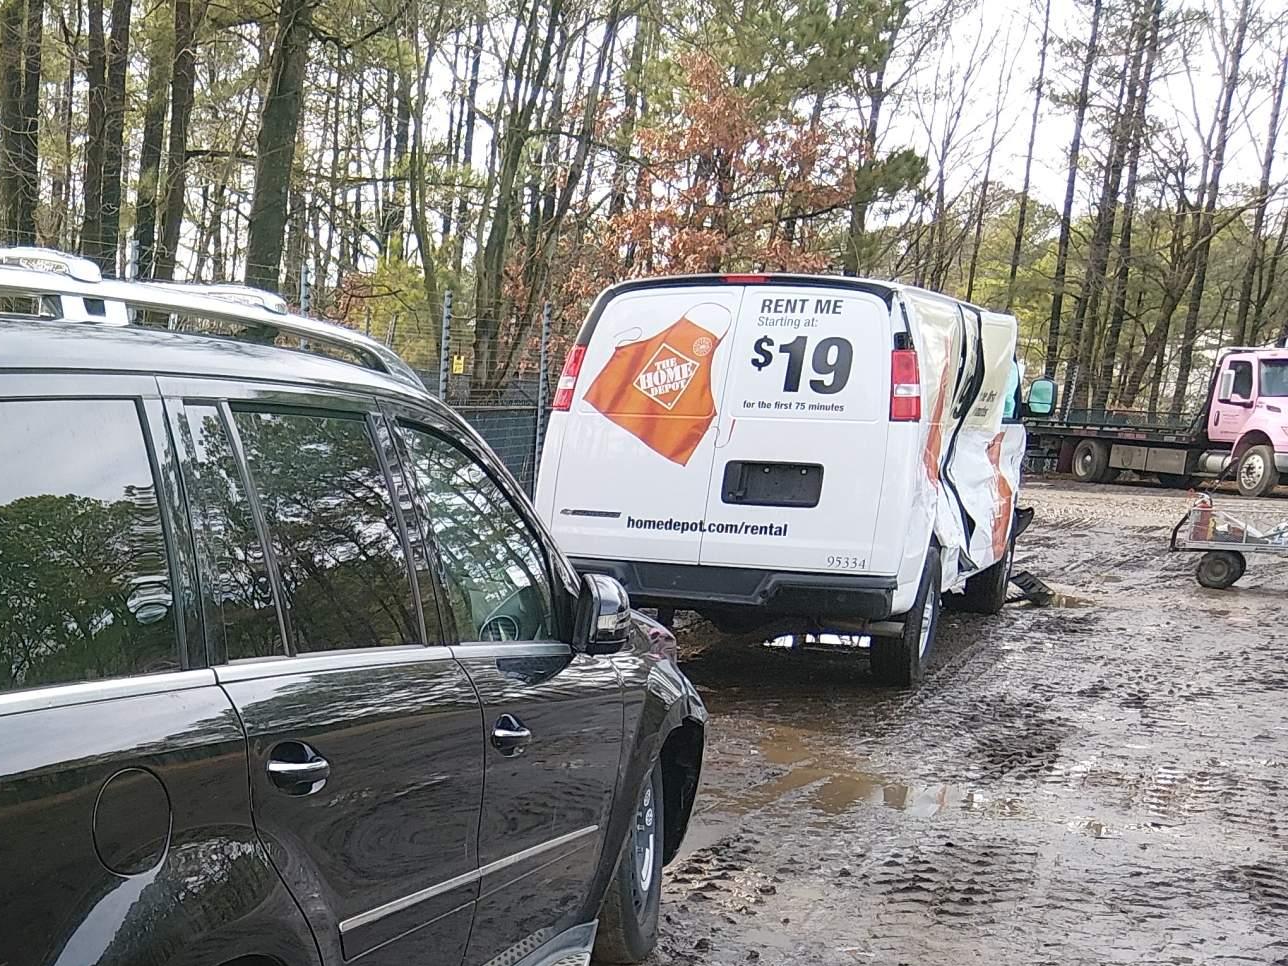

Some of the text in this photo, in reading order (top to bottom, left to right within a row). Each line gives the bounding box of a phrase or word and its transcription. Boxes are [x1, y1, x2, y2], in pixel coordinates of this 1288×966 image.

[760, 298, 844, 315] RENT ME
[757, 315, 819, 329] Starting at:
[654, 357, 678, 371] THE
[751, 335, 854, 394] $19
[639, 362, 693, 390] HOME
[650, 379, 687, 396] DEPOT
[743, 400, 845, 412] for the first 75 minutes
[626, 516, 788, 537] homedepot.com/rental
[827, 555, 867, 570] 95334
